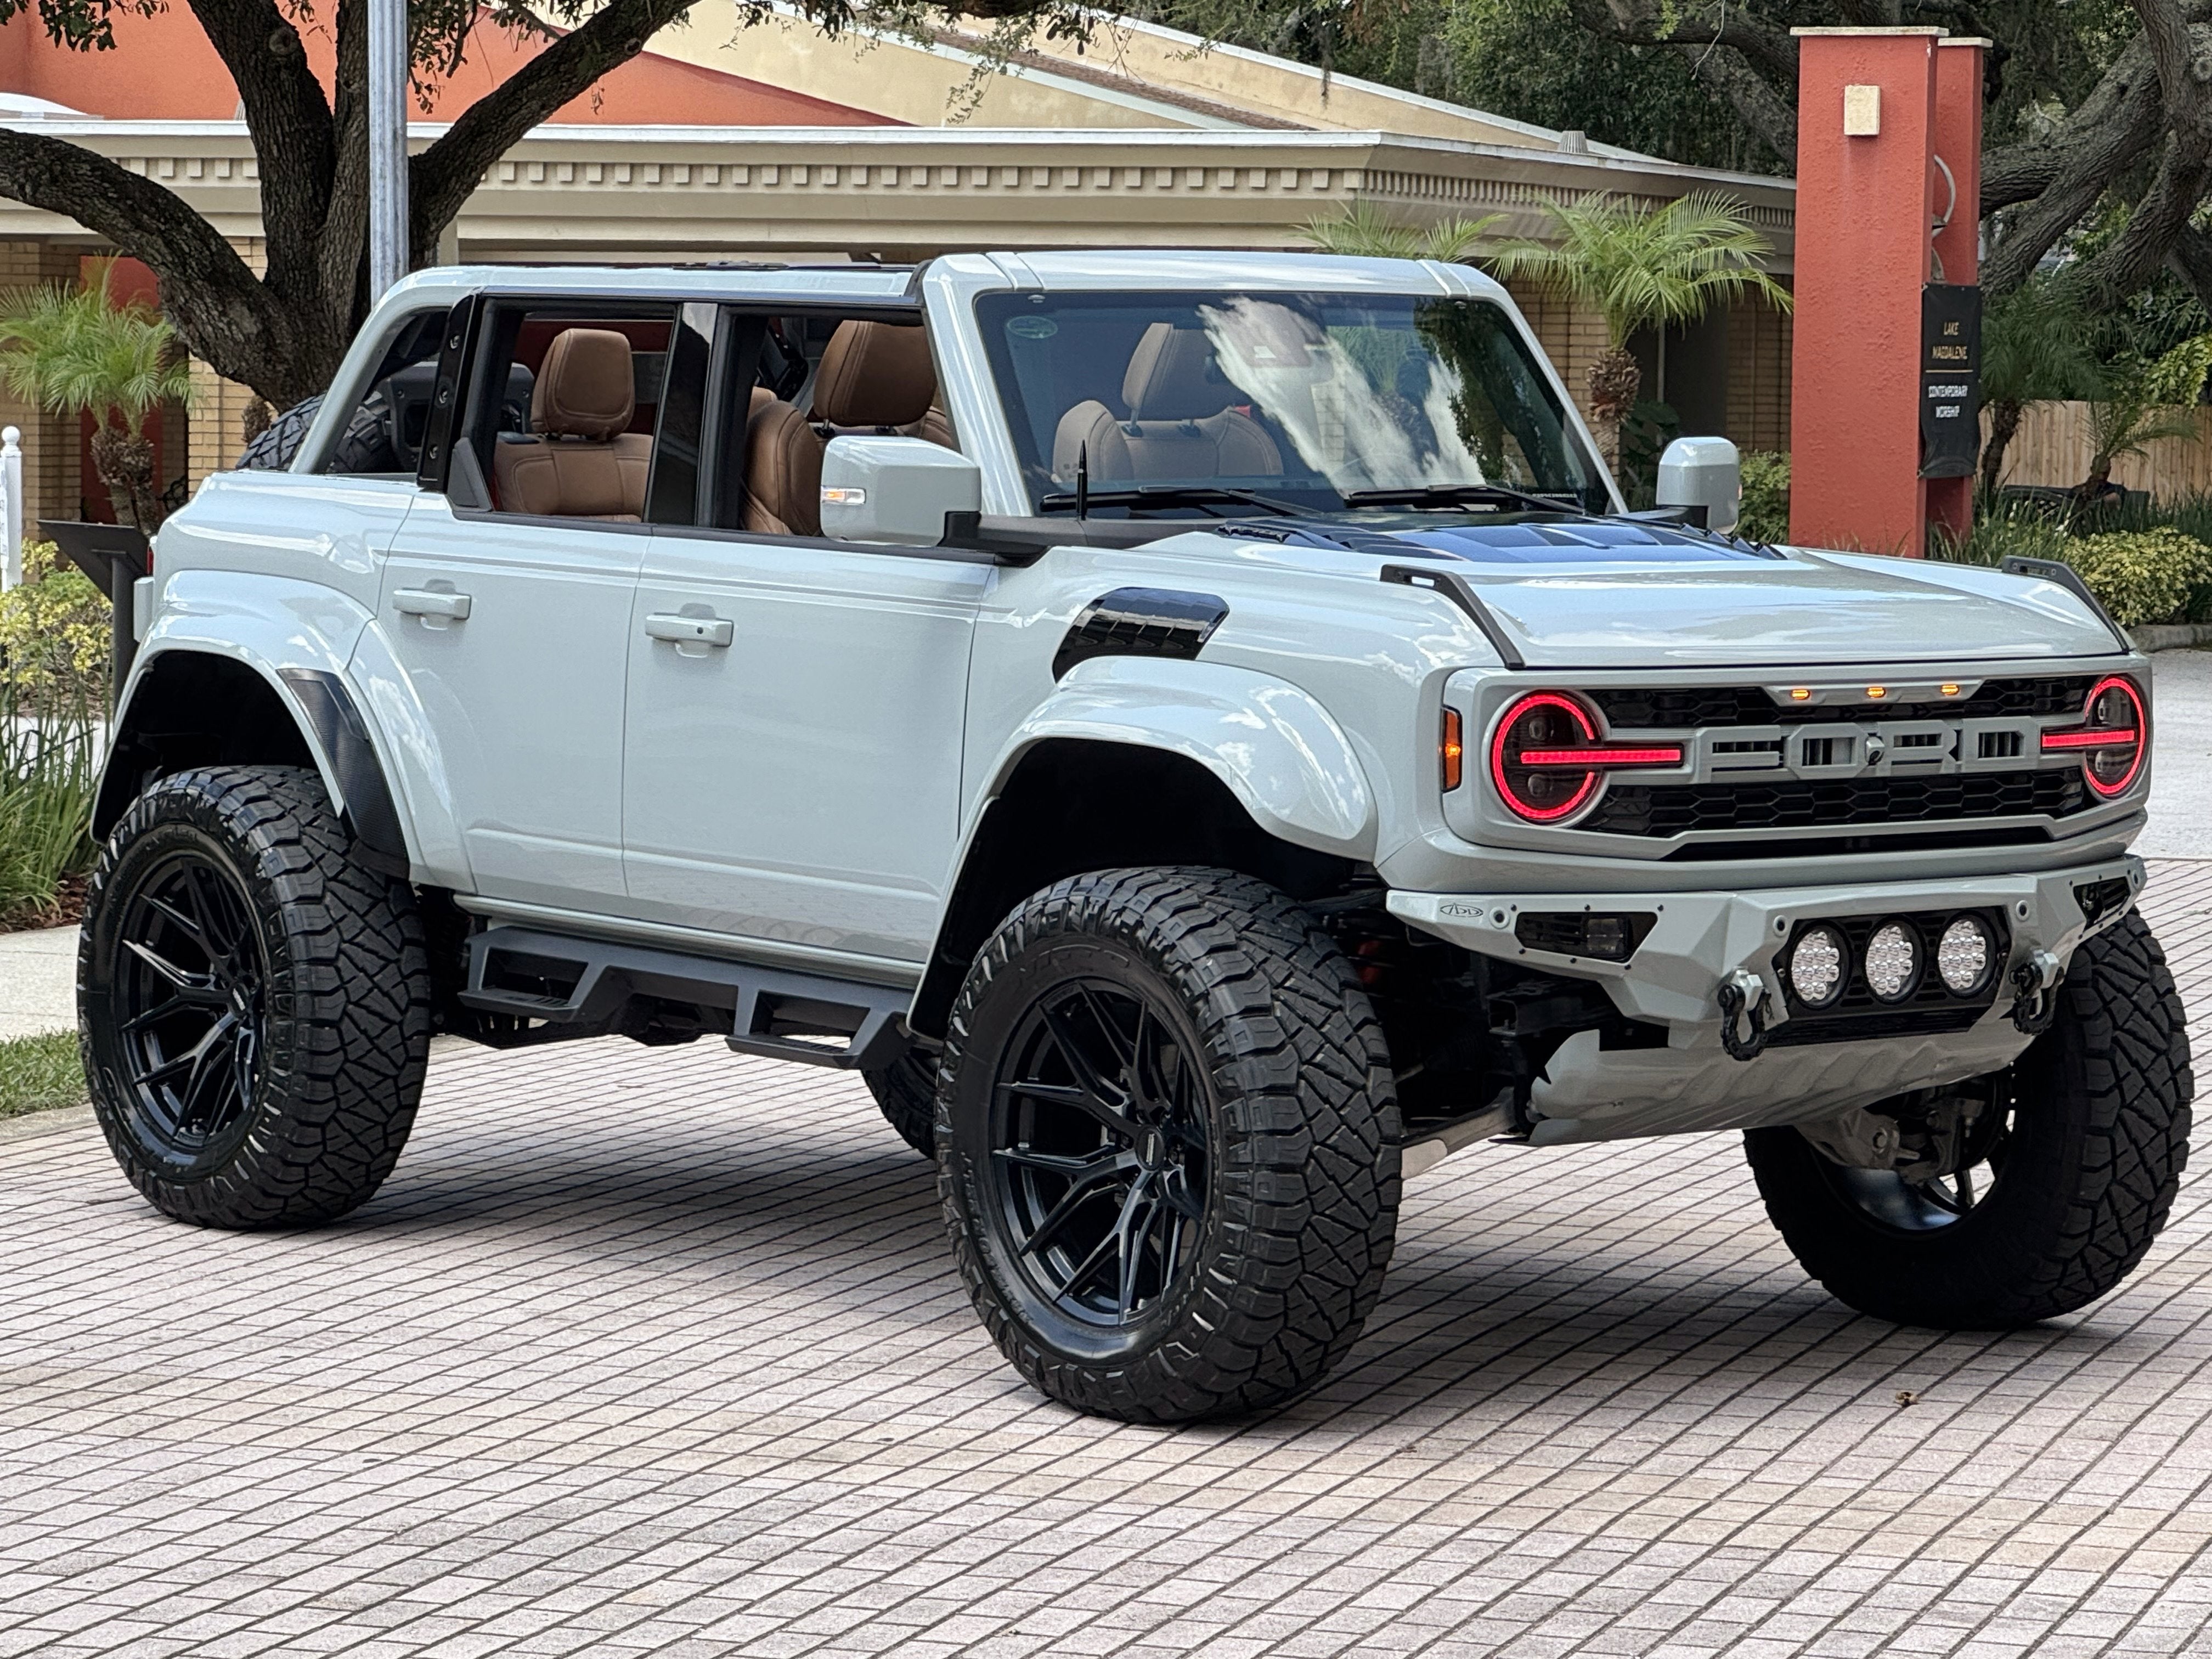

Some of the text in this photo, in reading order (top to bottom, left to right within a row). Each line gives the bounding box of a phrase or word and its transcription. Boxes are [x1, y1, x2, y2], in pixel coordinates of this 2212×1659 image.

[1944, 321, 1959, 336] LAKE
[1932, 346, 1967, 359] MAGDALENE
[1928, 385, 1968, 398] CONTEMPORARY
[1692, 716, 2039, 783] FORD
